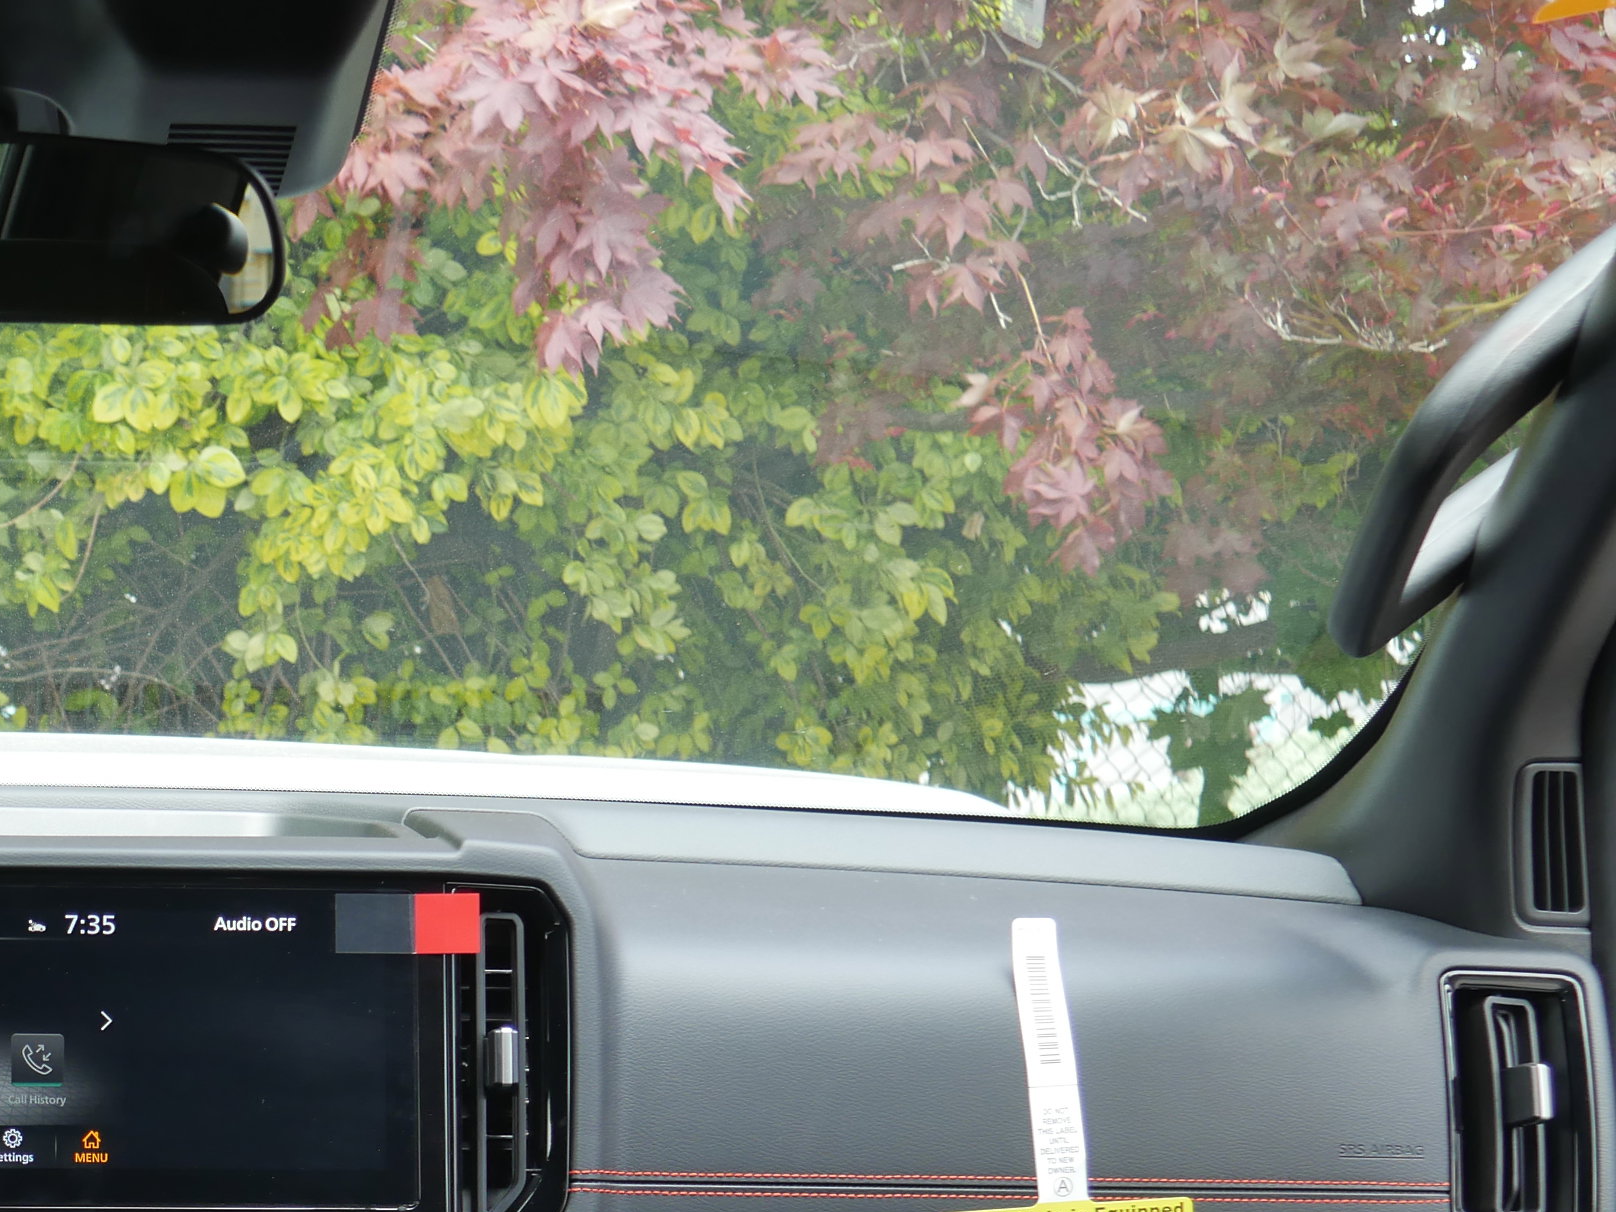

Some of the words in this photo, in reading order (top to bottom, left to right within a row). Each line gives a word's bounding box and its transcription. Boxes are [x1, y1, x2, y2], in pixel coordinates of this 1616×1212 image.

[65, 915, 115, 934] 7:35
[214, 916, 262, 932] Audio
[265, 917, 297, 932] OFF
[8, 1094, 29, 1105] Call
[31, 1094, 66, 1107] History
[75, 1153, 108, 1163] MENU
